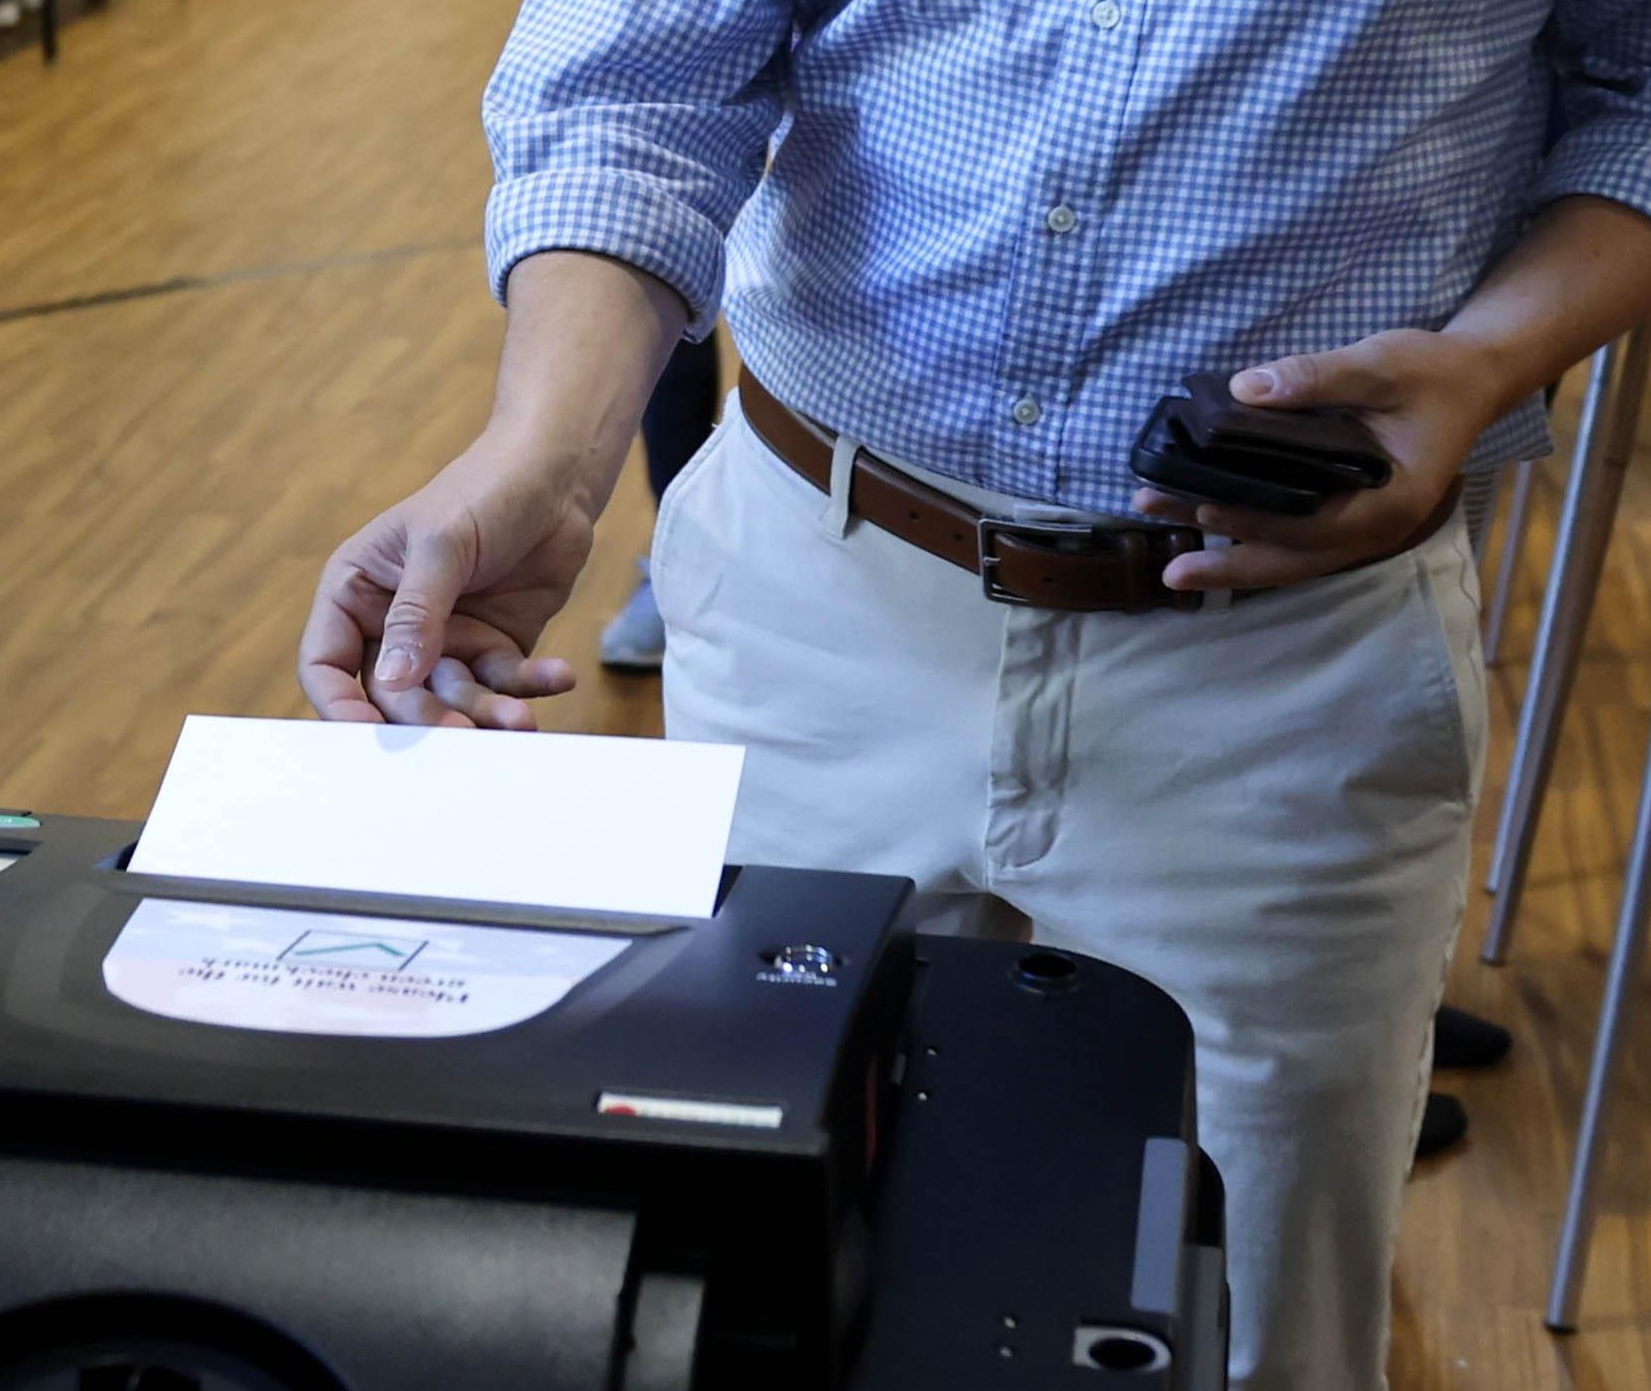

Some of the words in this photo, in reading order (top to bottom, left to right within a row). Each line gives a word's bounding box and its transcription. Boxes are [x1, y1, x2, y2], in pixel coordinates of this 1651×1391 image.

[178, 967, 225, 981] the
[237, 973, 280, 986] for
[294, 977, 355, 990] wait
[367, 984, 469, 1003] Please
